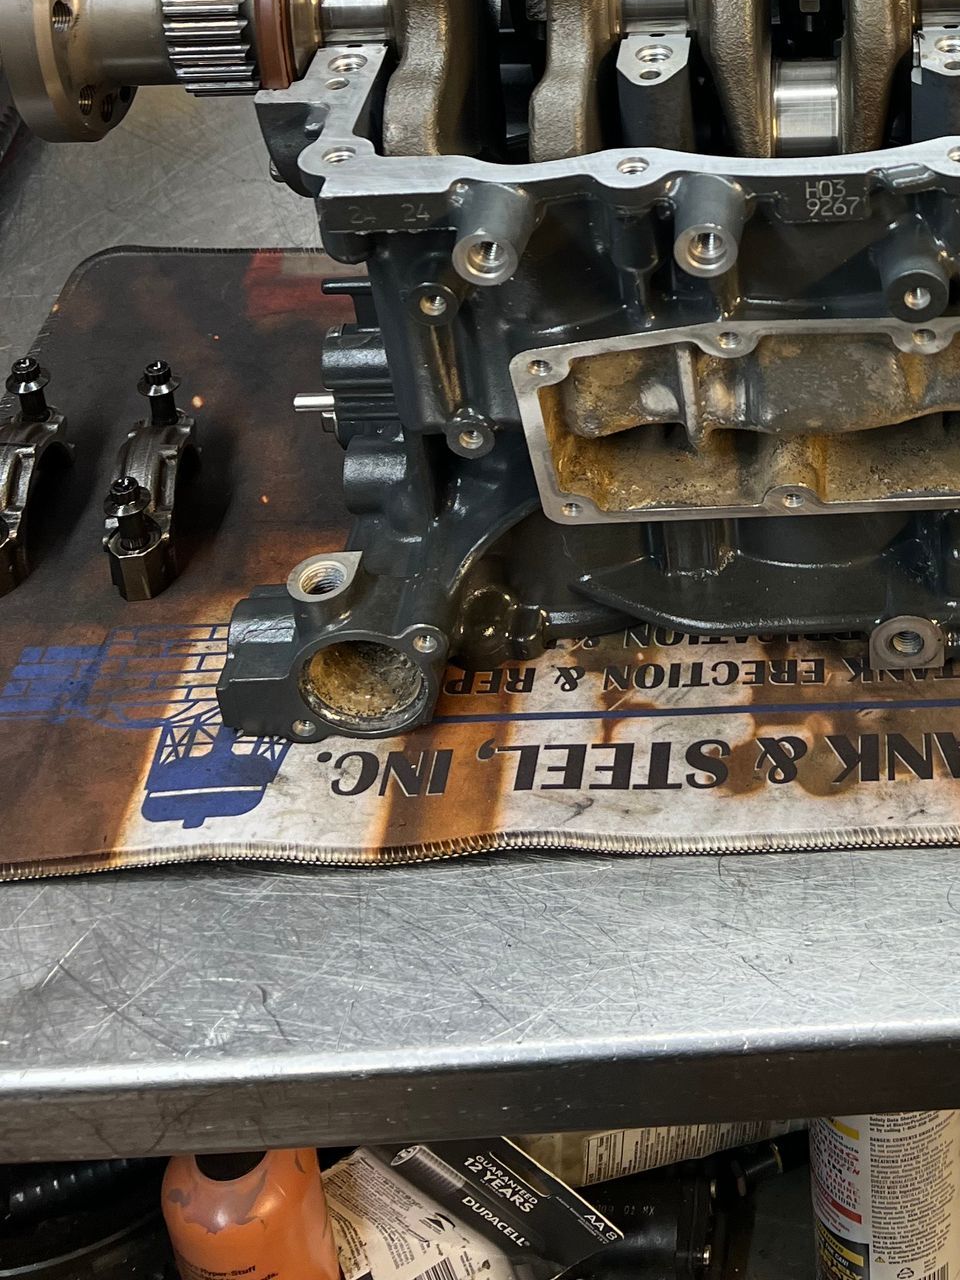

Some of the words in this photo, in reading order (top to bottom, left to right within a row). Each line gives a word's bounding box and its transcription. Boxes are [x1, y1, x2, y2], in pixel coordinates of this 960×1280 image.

[401, 203, 431, 222] 24
[805, 198, 861, 218] 9267
[553, 664, 586, 693] &
[602, 657, 827, 694] ERECTION
[316, 748, 453, 799] INC.
[476, 735, 731, 792] STEEL,
[756, 736, 808, 787] &
[463, 1156, 484, 1174] 12
[483, 1170, 535, 1214] YEARS
[475, 1154, 539, 1205] GUARANTEED
[461, 1195, 527, 1248] DURACELL
[584, 1214, 605, 1231] AA
[605, 1231, 618, 1241] 8
